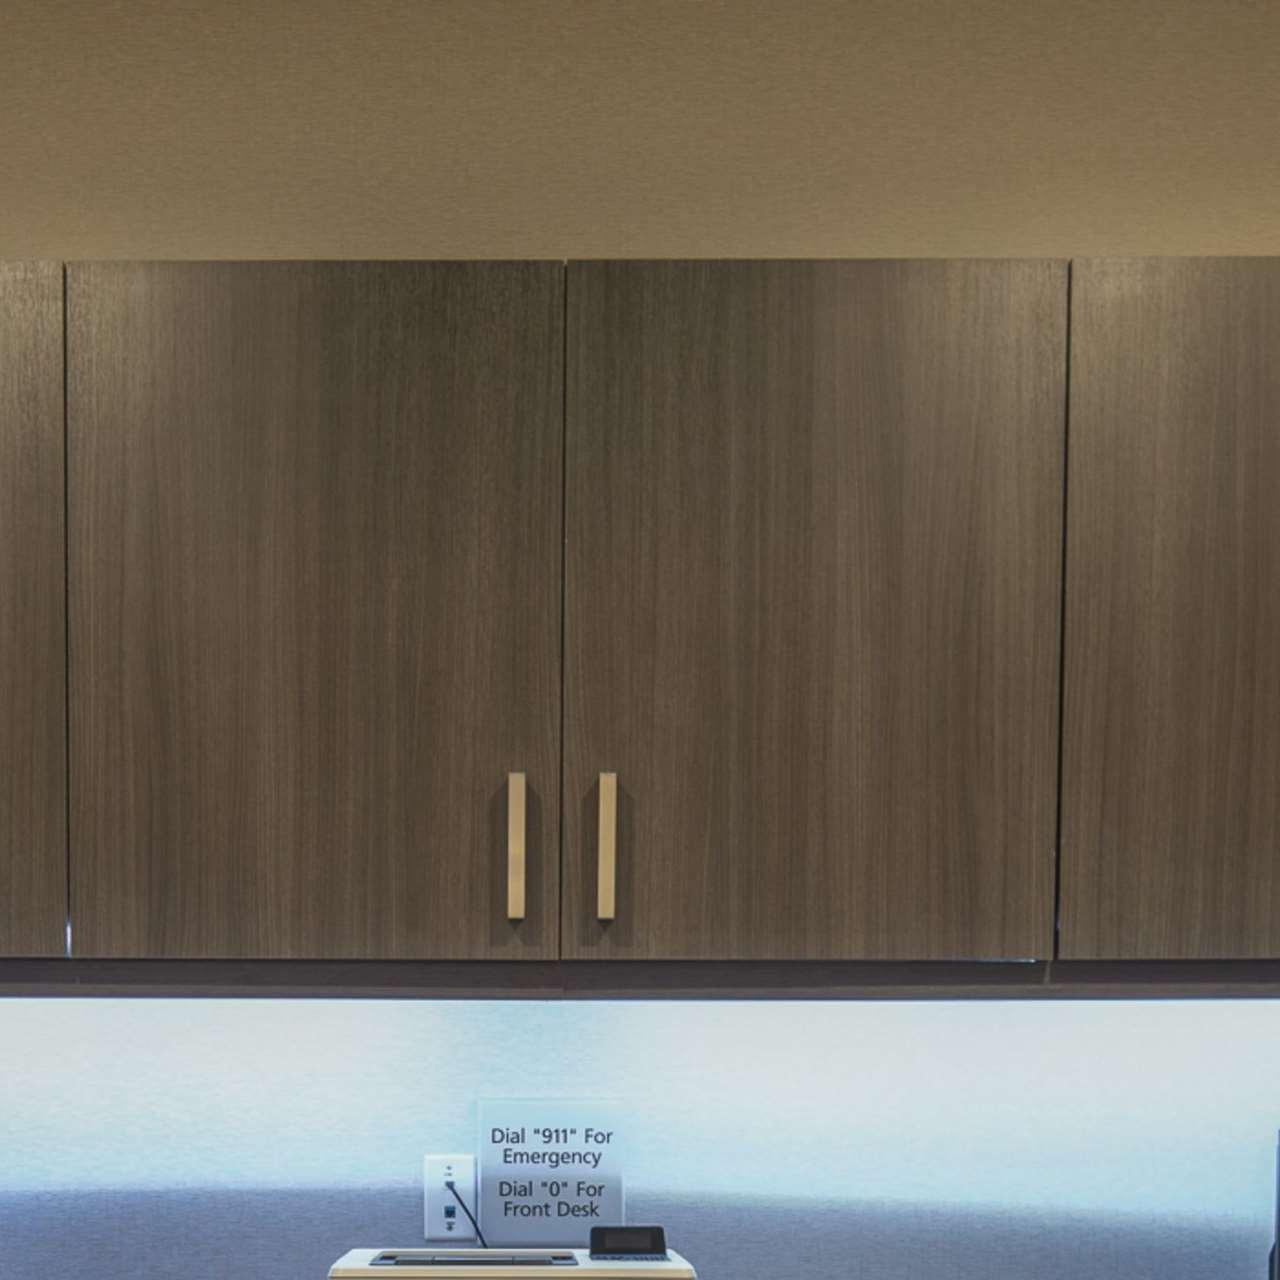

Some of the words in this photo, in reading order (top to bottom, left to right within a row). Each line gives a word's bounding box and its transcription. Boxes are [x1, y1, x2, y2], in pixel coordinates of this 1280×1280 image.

[491, 1127, 526, 1144] Dial
[533, 1127, 577, 1144] "911"
[584, 1128, 613, 1144] For
[503, 1148, 602, 1169] Emergency
[499, 1181, 533, 1197] Dial
[541, 1181, 568, 1197] "0"
[577, 1181, 605, 1197] For
[504, 1201, 551, 1217] Front
[557, 1201, 600, 1217] Desk
